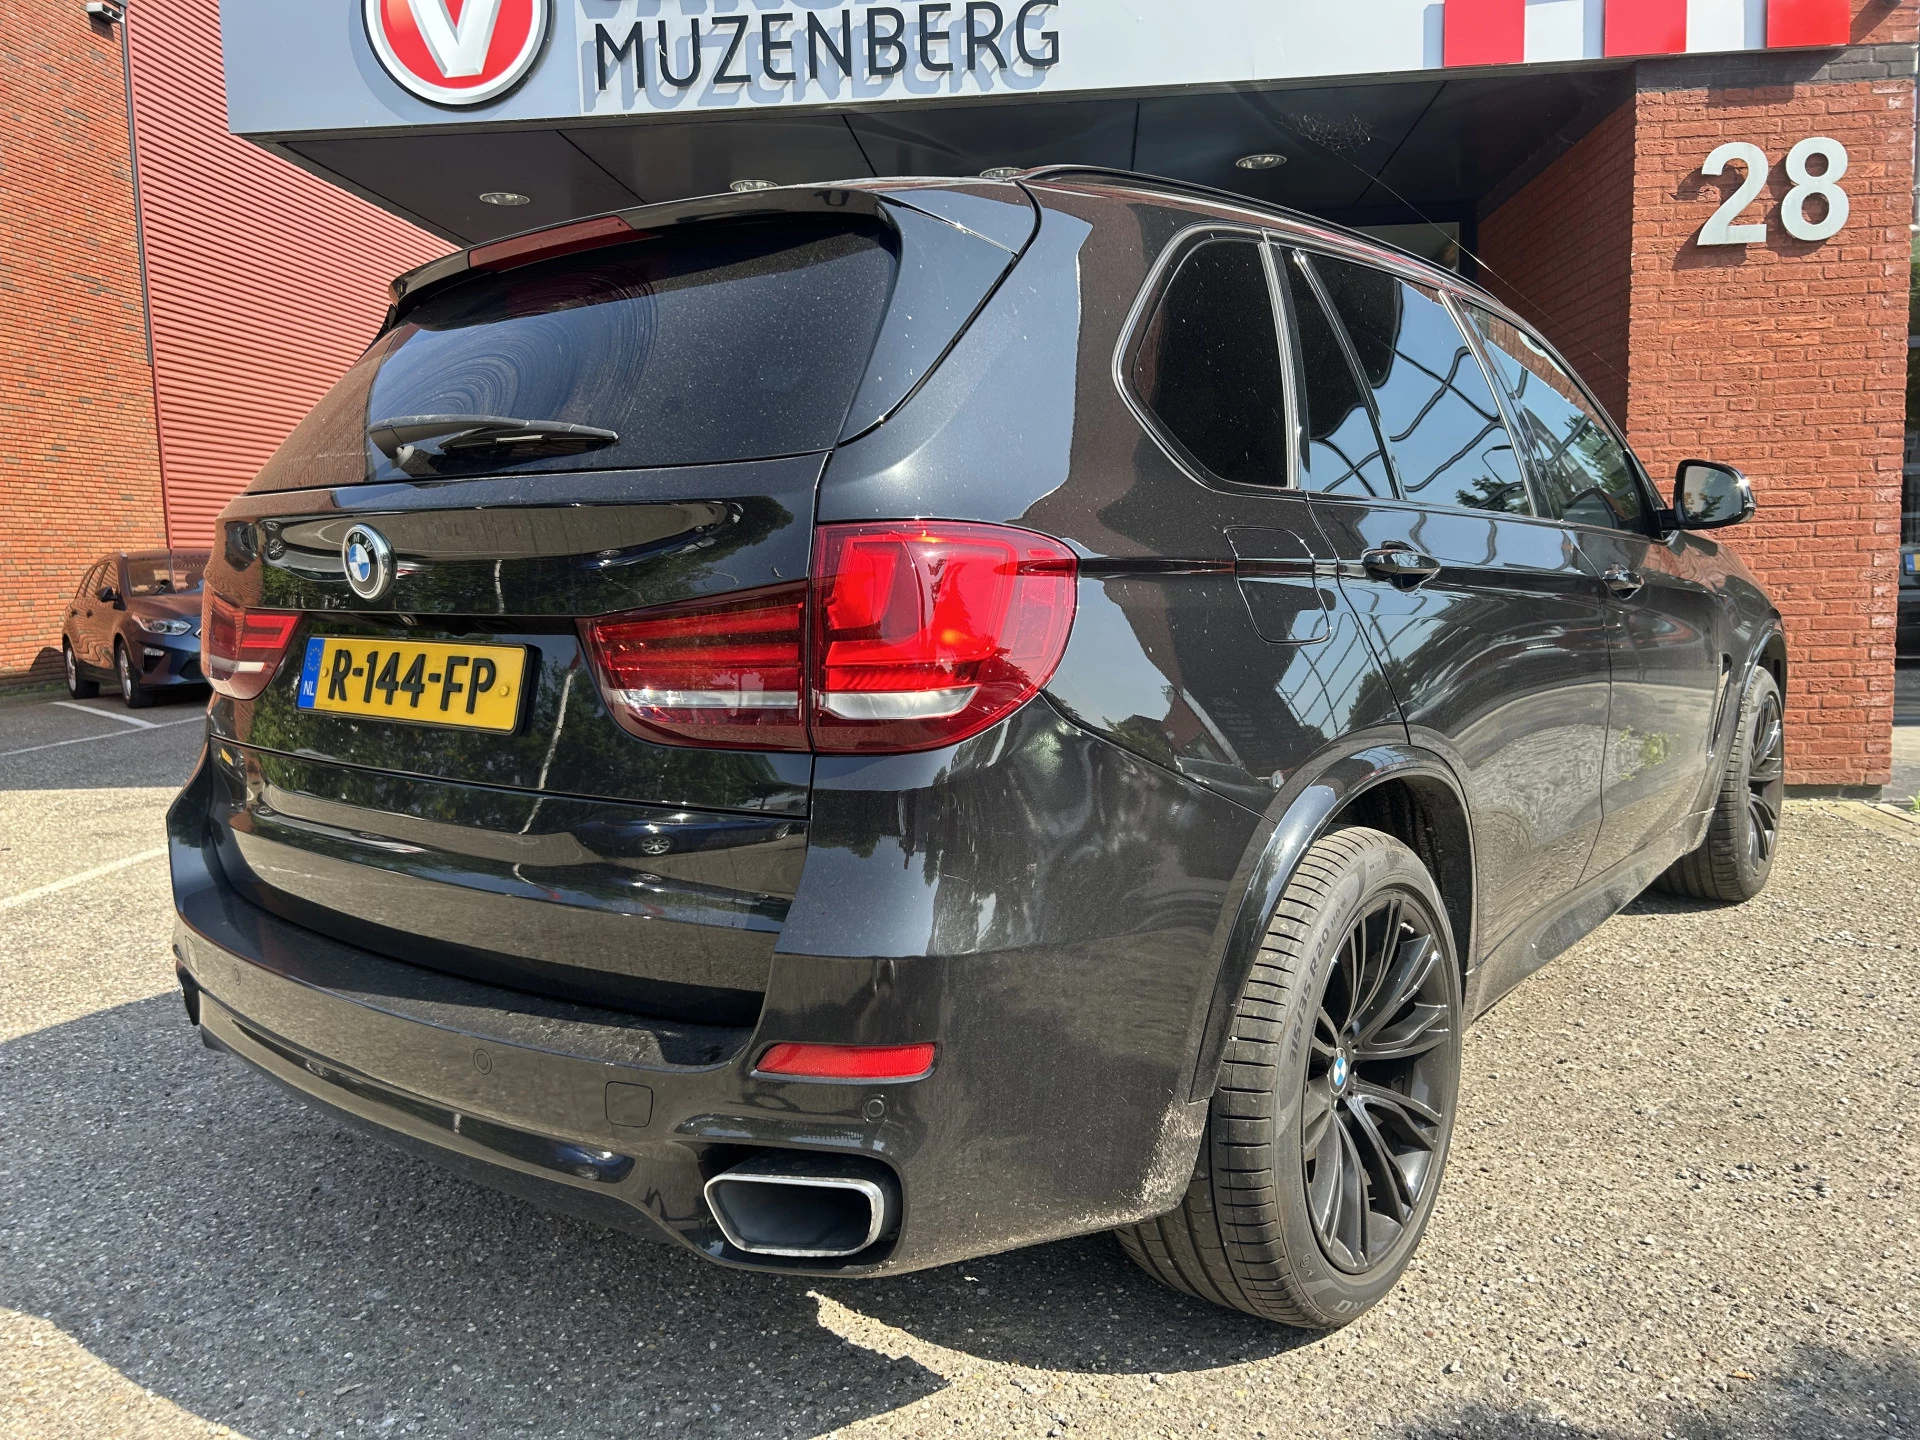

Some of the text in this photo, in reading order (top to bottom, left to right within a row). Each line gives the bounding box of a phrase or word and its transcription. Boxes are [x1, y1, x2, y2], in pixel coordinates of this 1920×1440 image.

[595, 0, 1060, 91] MUZENBERG
[1697, 136, 1850, 246] 28
[302, 680, 315, 696] NL
[327, 648, 497, 715] R-144-FP
[1289, 978, 1312, 1067] 315/35
[1310, 927, 1330, 977] R20
